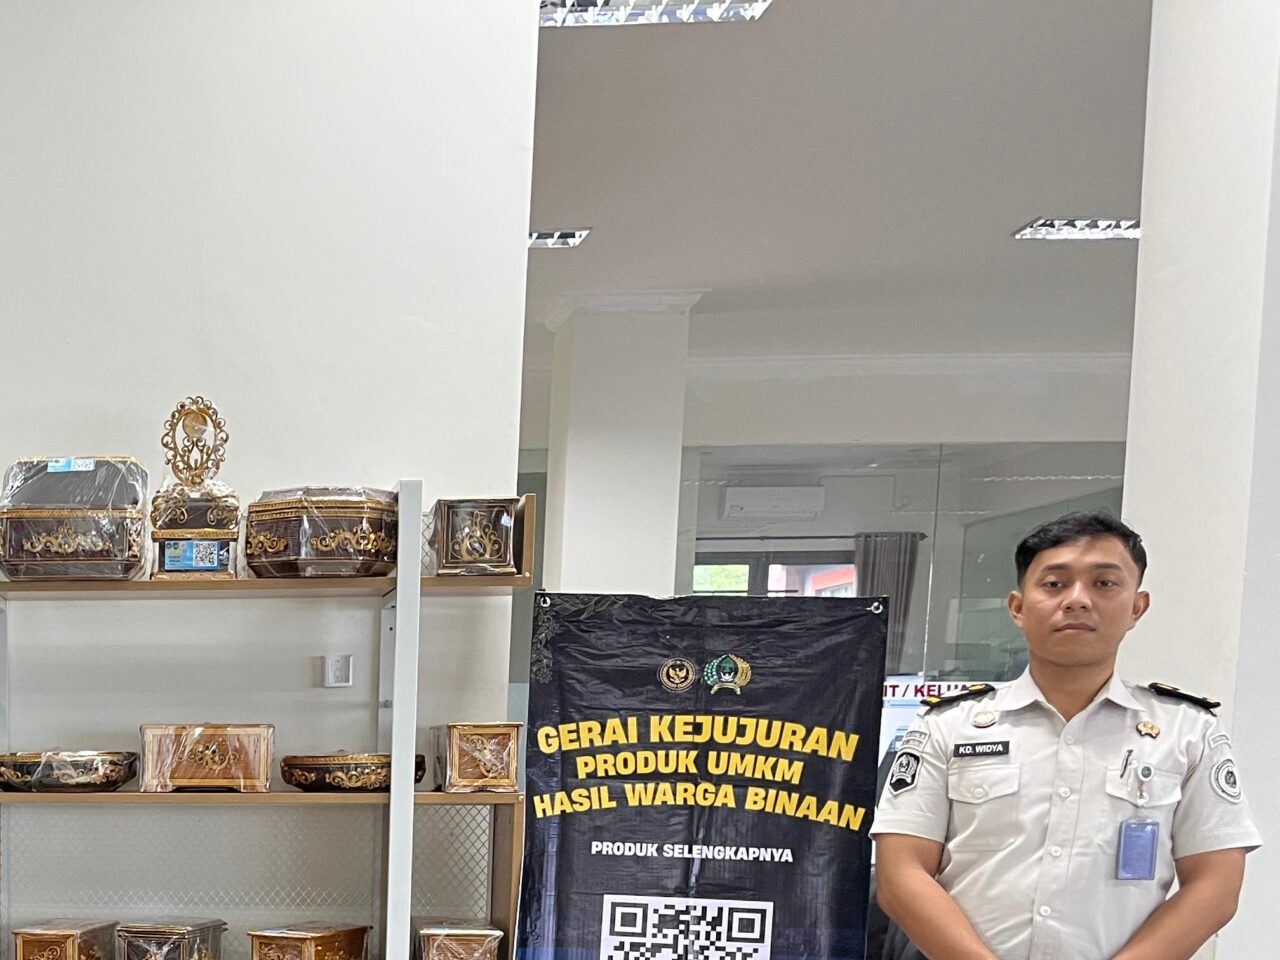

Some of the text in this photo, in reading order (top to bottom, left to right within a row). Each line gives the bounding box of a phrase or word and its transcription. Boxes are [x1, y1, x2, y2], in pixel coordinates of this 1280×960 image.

[537, 714, 860, 762] GERAI KEJUJURAN
[959, 744, 1003, 754] KD. WIDYA
[576, 750, 804, 785] PRODUK UMKM
[533, 782, 866, 831] HASIL WARGA BINAAN
[591, 841, 793, 863] PRODUK SELENGKAPNYA
